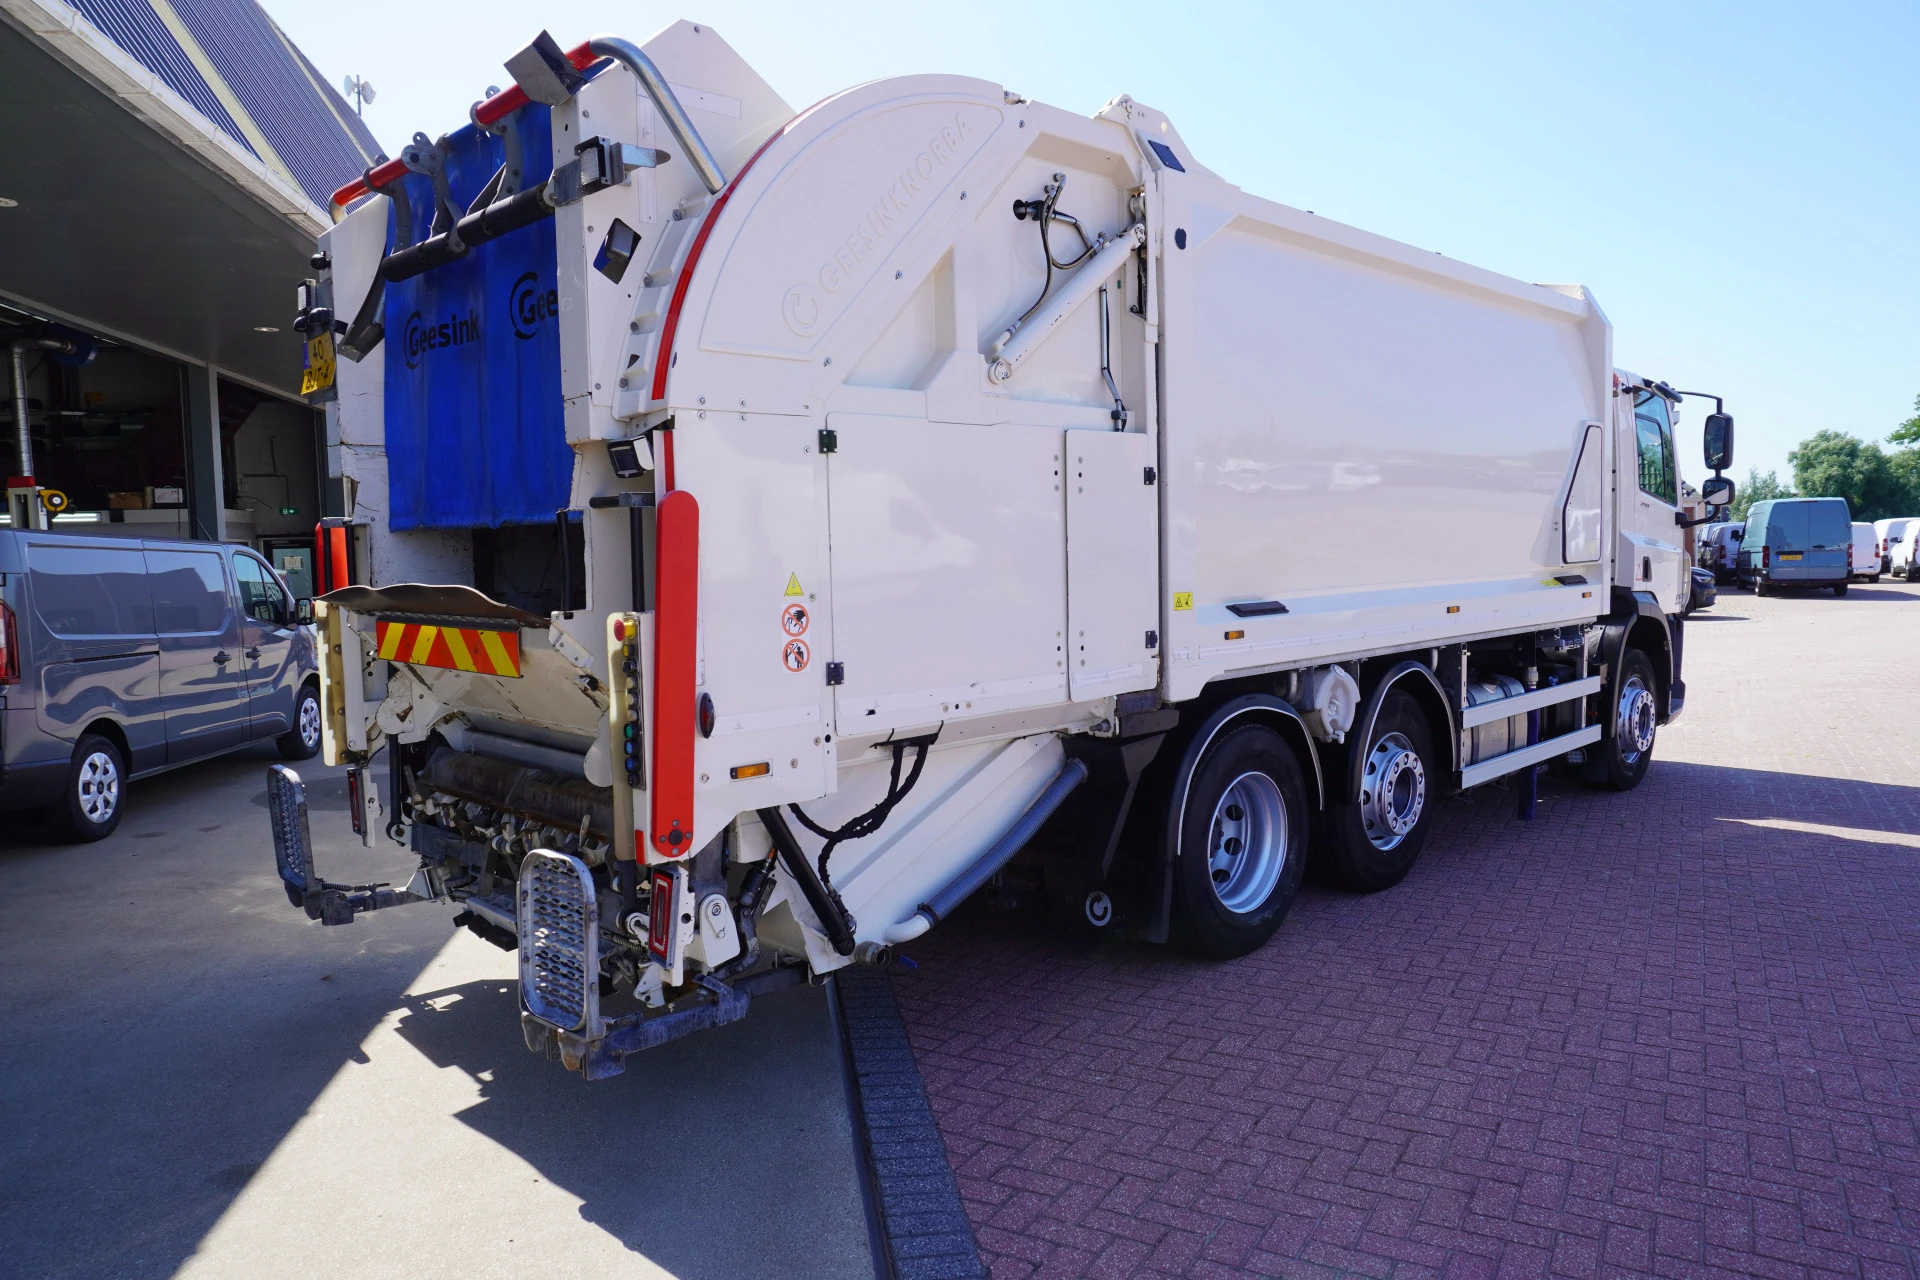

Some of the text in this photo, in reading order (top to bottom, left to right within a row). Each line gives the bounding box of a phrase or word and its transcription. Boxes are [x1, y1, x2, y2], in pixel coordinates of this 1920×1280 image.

[819, 112, 974, 293] GEESINKNORBA
[313, 339, 324, 362] 40
[408, 308, 479, 358] Geesink
